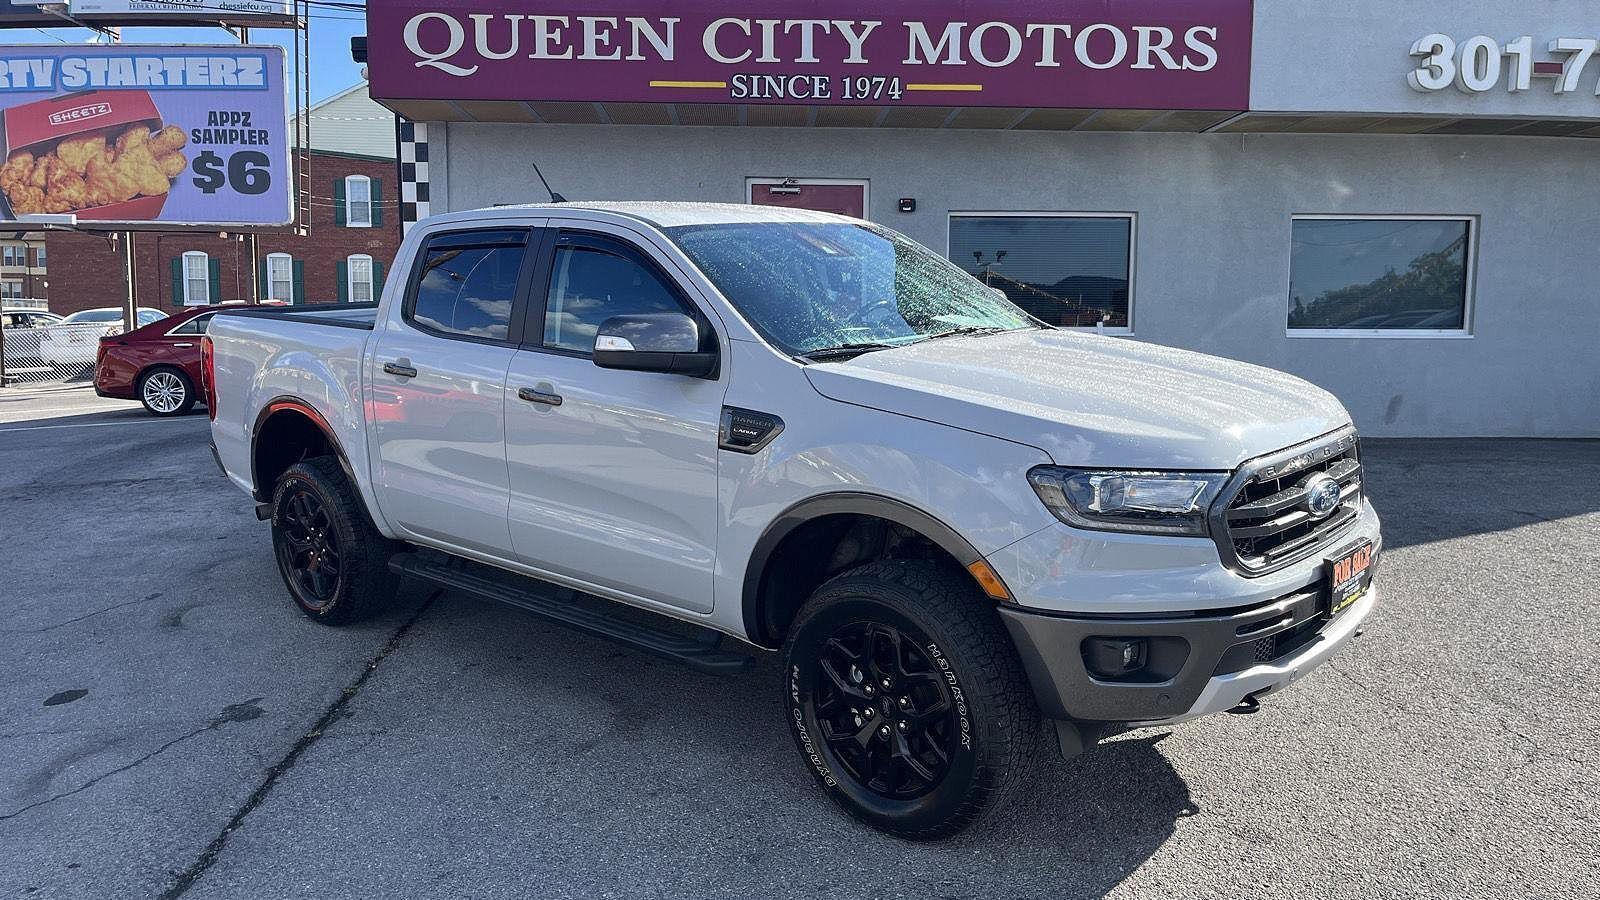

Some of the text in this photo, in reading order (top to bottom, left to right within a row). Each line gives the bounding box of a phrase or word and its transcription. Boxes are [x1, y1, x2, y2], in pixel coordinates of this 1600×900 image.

[219, 2, 272, 13] chessiefcu.org
[402, 12, 1218, 76] QUEEN CITY MOTORS
[61, 57, 264, 87] STARTERZ
[731, 74, 903, 101] SINCE 1974
[52, 105, 107, 123] SHEETZ
[208, 111, 252, 127] APPZ
[191, 128, 269, 145] SAMPLER
[192, 151, 271, 194] $6
